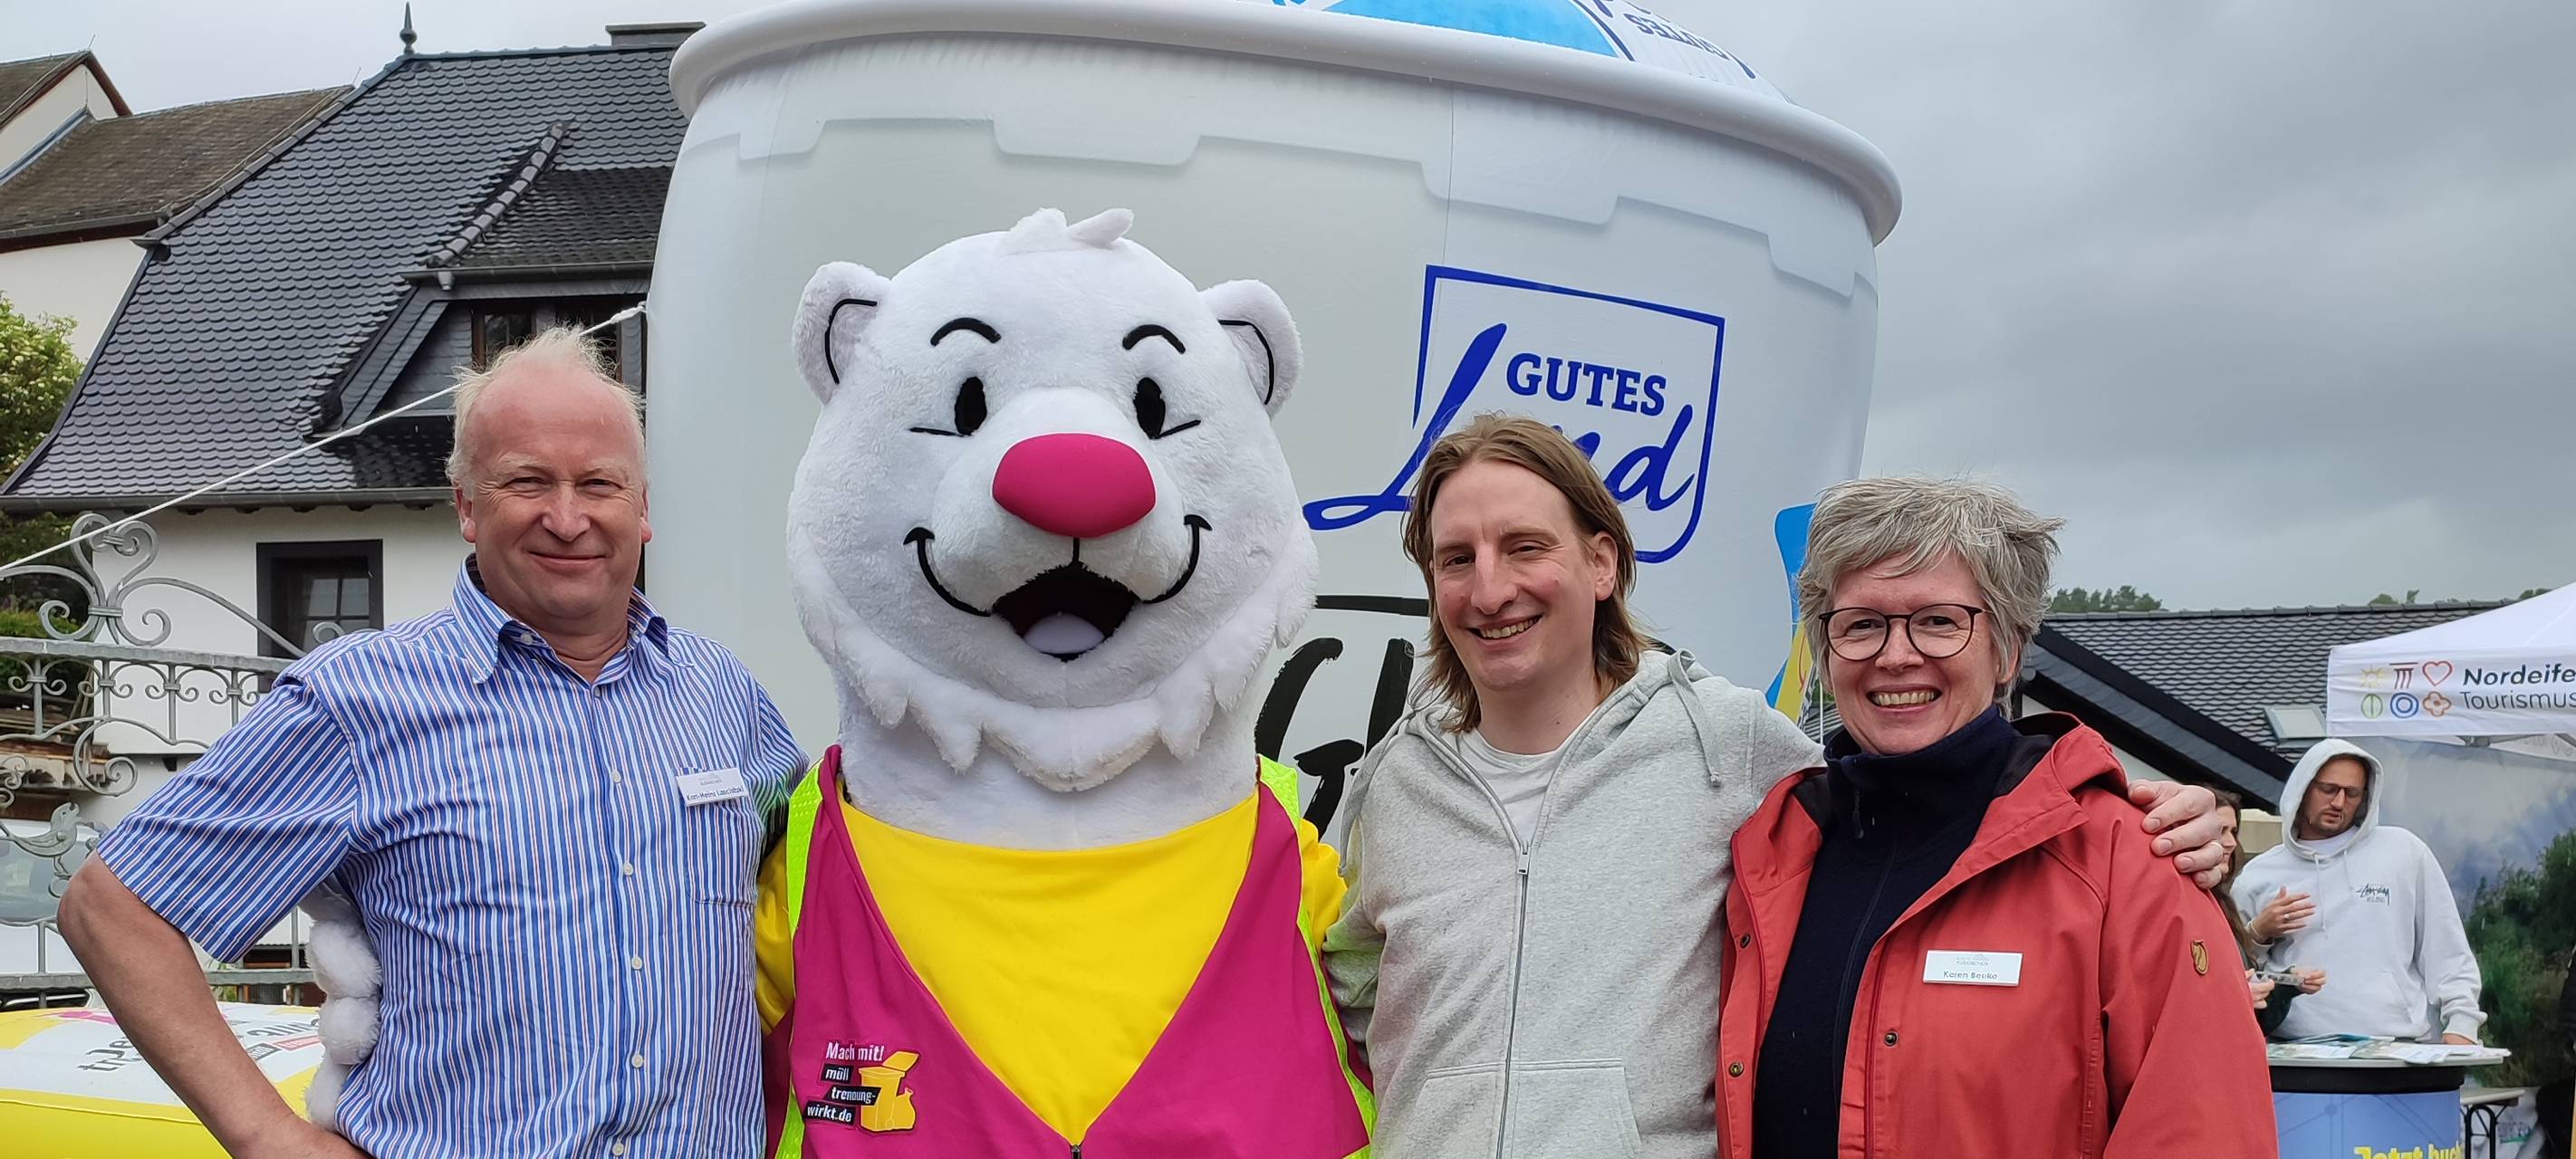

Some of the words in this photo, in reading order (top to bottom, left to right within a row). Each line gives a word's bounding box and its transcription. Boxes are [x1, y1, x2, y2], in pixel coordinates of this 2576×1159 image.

[1623, 13, 1730, 61] GUTES
[1506, 352, 1667, 417] GUTES
[1302, 322, 1696, 531] Ld
[826, 1041, 855, 1061] Mach
[858, 1044, 885, 1062] mit!
[825, 1067, 850, 1081] müll
[831, 1087, 876, 1104] trennung-
[807, 1104, 851, 1122] wirkt.de
